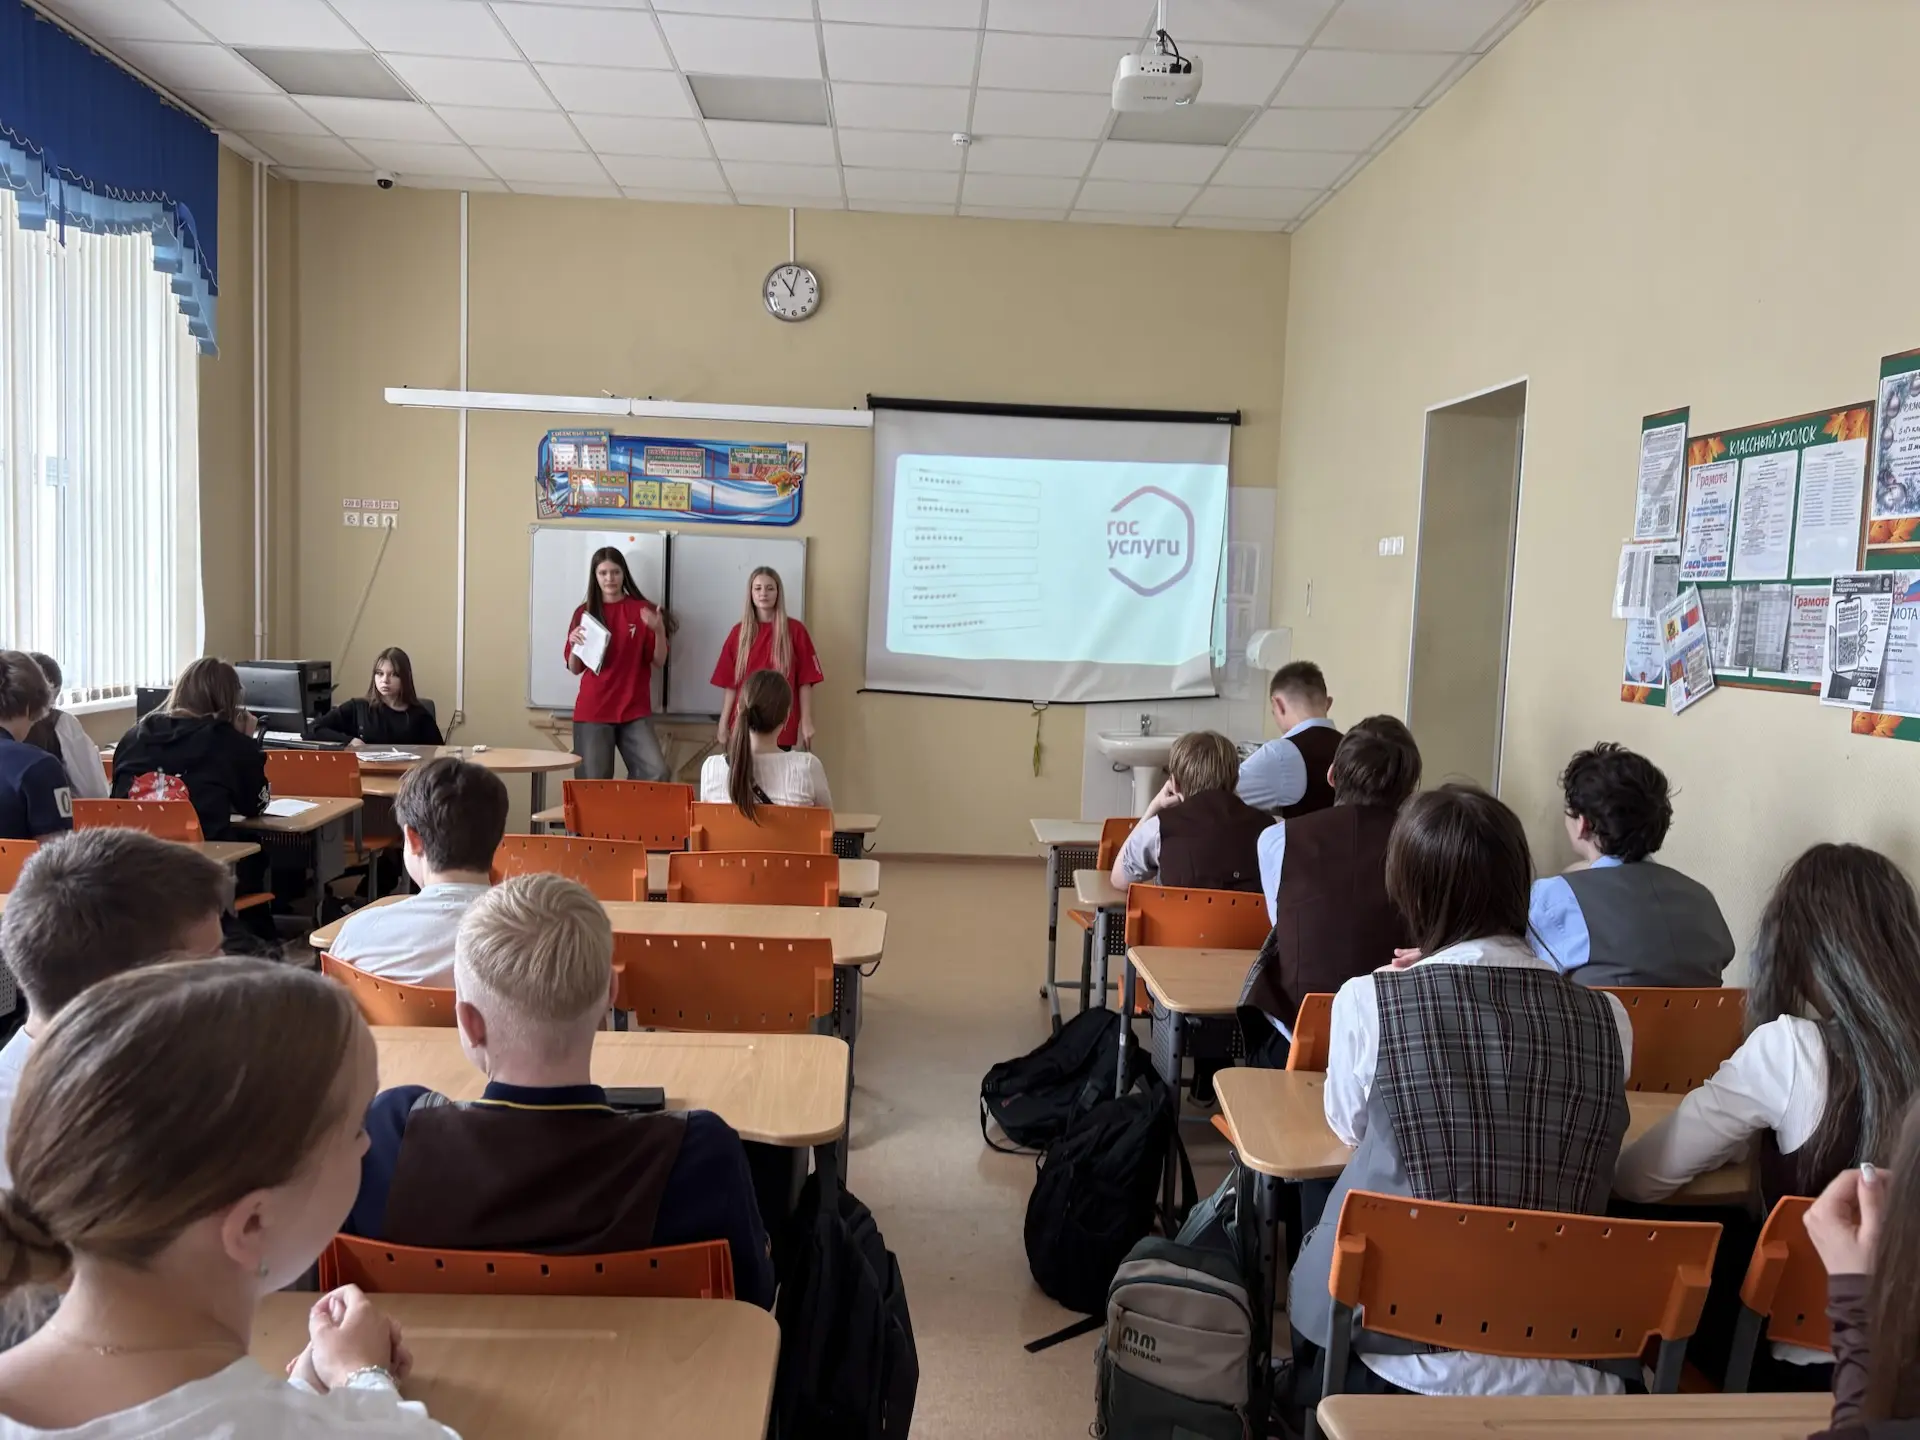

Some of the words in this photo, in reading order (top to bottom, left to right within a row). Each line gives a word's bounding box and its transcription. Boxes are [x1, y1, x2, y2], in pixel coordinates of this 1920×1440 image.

[1729, 428, 1777, 456] КЛАССНЫЙ
[1778, 425, 1817, 448] УГОЛОК
[1696, 471, 1728, 489] Грамота
[1107, 520, 1139, 536] гос
[1107, 539, 1180, 559] услуги
[1794, 595, 1829, 609] Грамота
